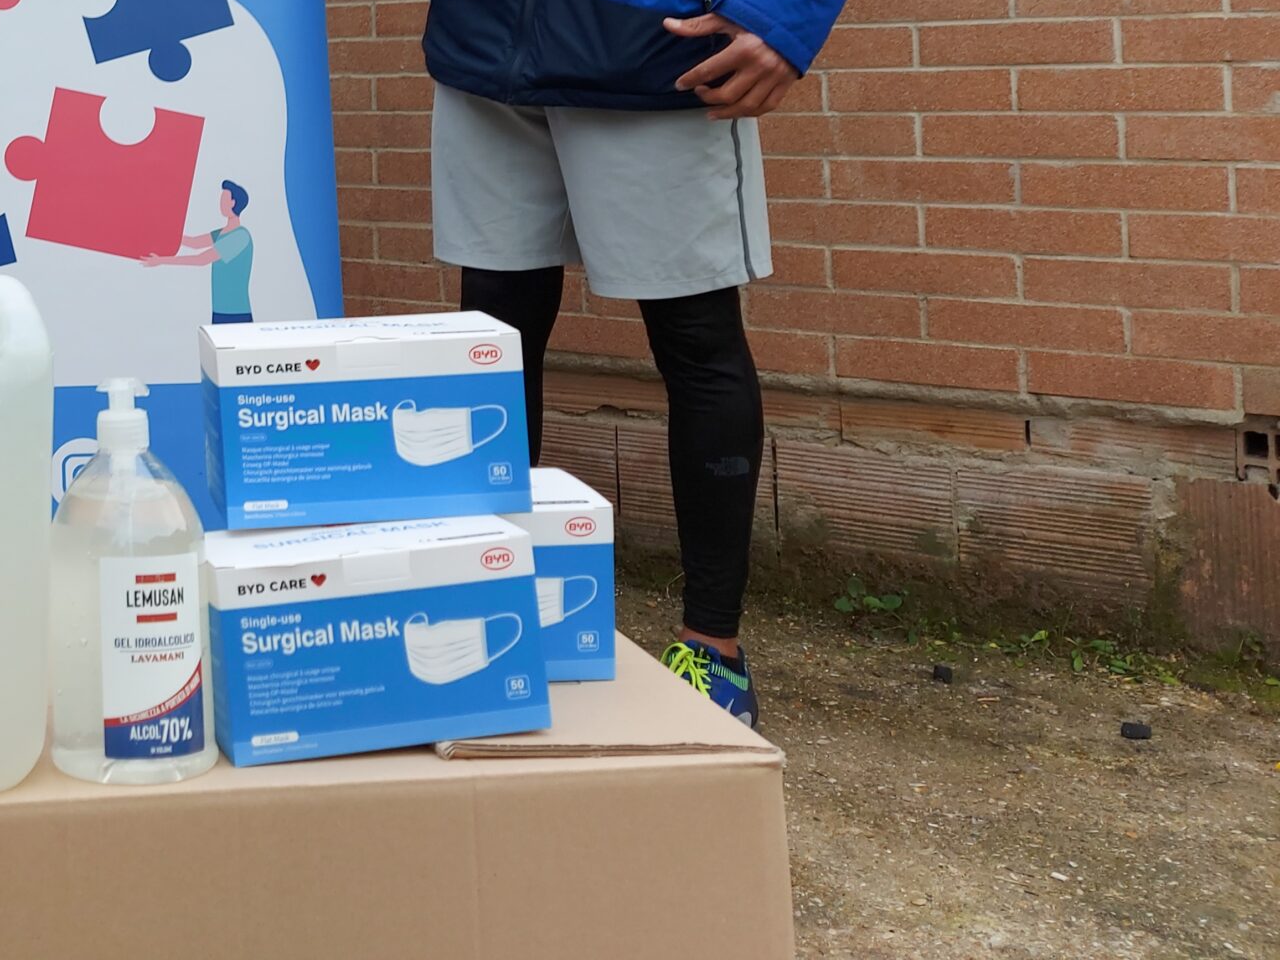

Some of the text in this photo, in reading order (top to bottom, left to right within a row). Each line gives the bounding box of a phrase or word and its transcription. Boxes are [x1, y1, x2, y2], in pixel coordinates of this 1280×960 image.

[471, 348, 499, 361] BYD
[236, 362, 302, 376] BYD CARE
[237, 393, 295, 407] Single-use
[238, 402, 389, 431] Surgical Mask
[493, 465, 507, 476] 50
[569, 520, 593, 532] BYD
[484, 551, 510, 565] BYD
[238, 578, 308, 596] BYD CARE
[126, 586, 185, 609] LEMUSAN
[240, 612, 302, 630] Single-use
[114, 633, 195, 650] GEL IDROALCOLICO
[241, 617, 401, 656] Surgical Mask
[581, 633, 594, 644] 50
[130, 651, 185, 664] LAVAMANI
[511, 680, 525, 691] 50
[130, 716, 193, 744] ALCOL 70%
